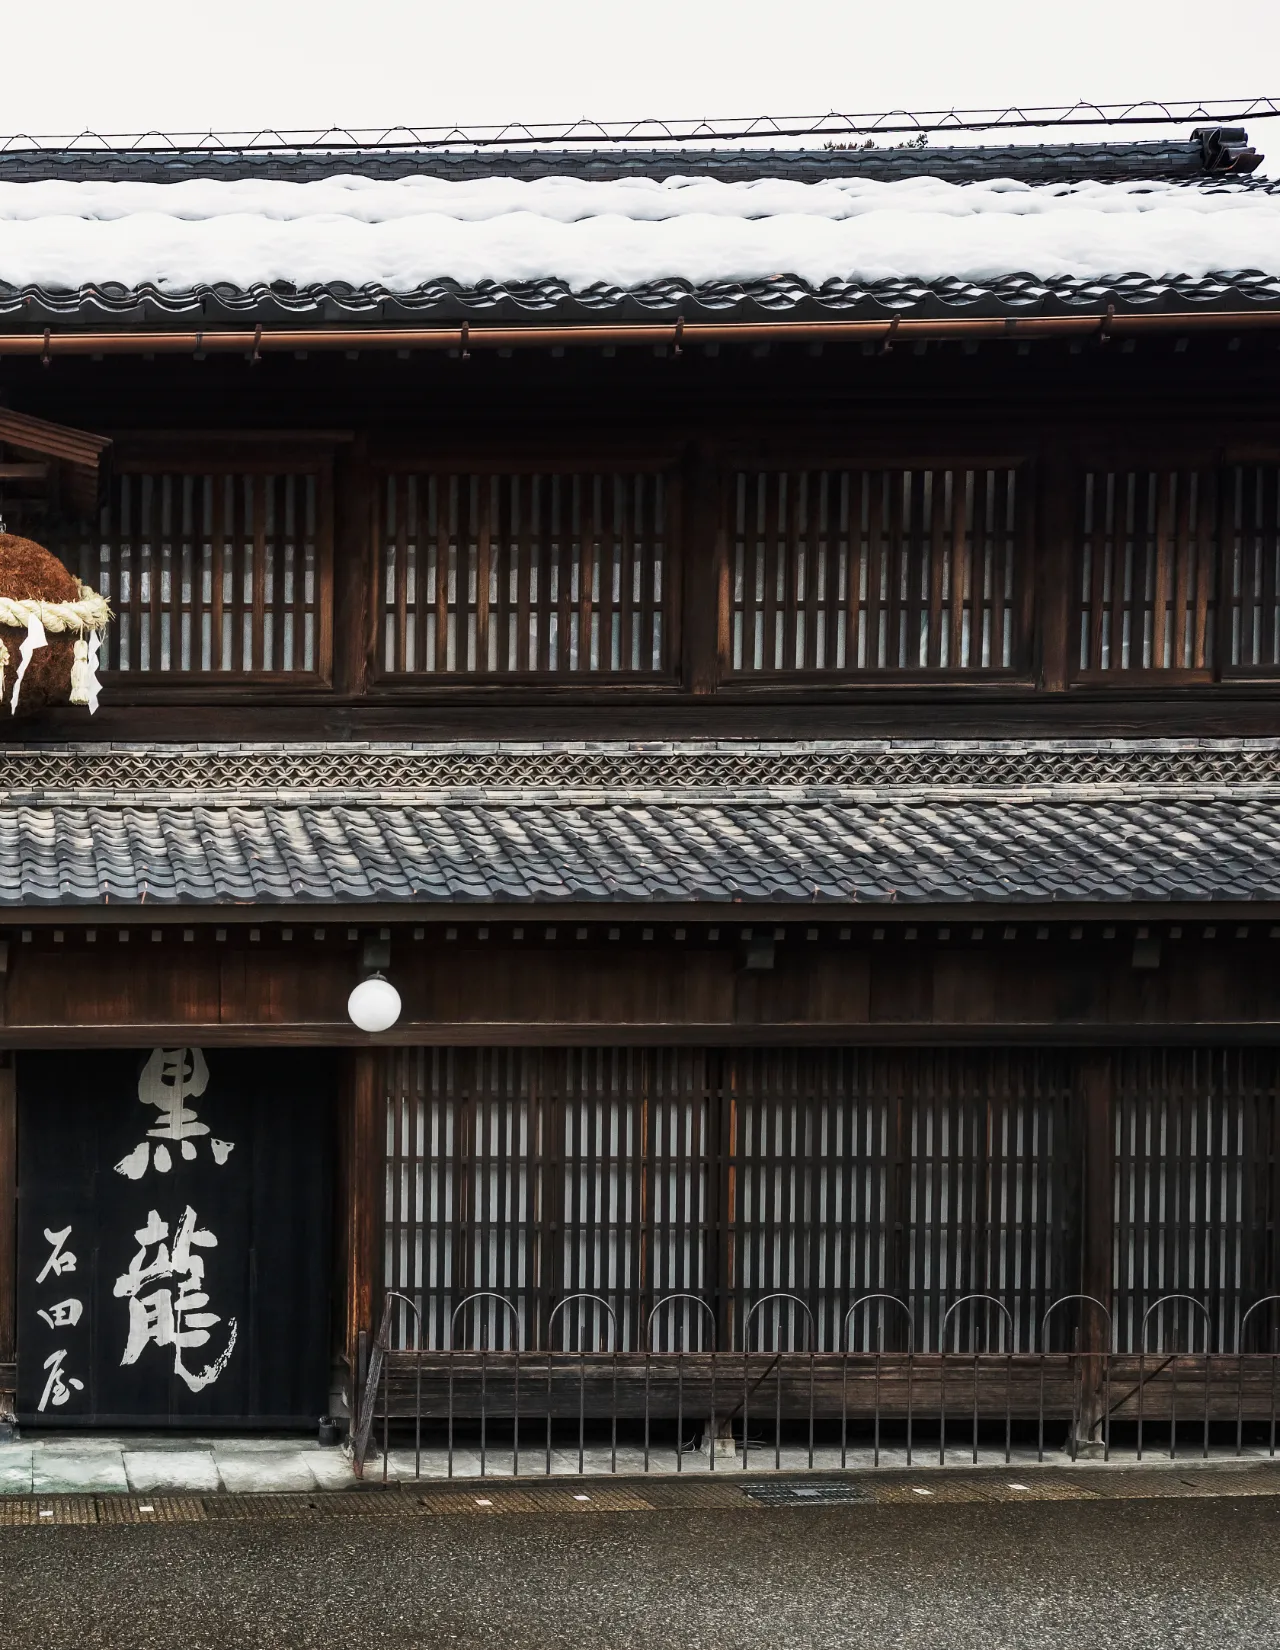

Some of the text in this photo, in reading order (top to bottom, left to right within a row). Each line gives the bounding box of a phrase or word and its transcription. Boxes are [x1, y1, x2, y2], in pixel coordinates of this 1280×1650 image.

[35, 1225, 85, 1413] 石田屋
[113, 1047, 238, 1393] 黒龍
